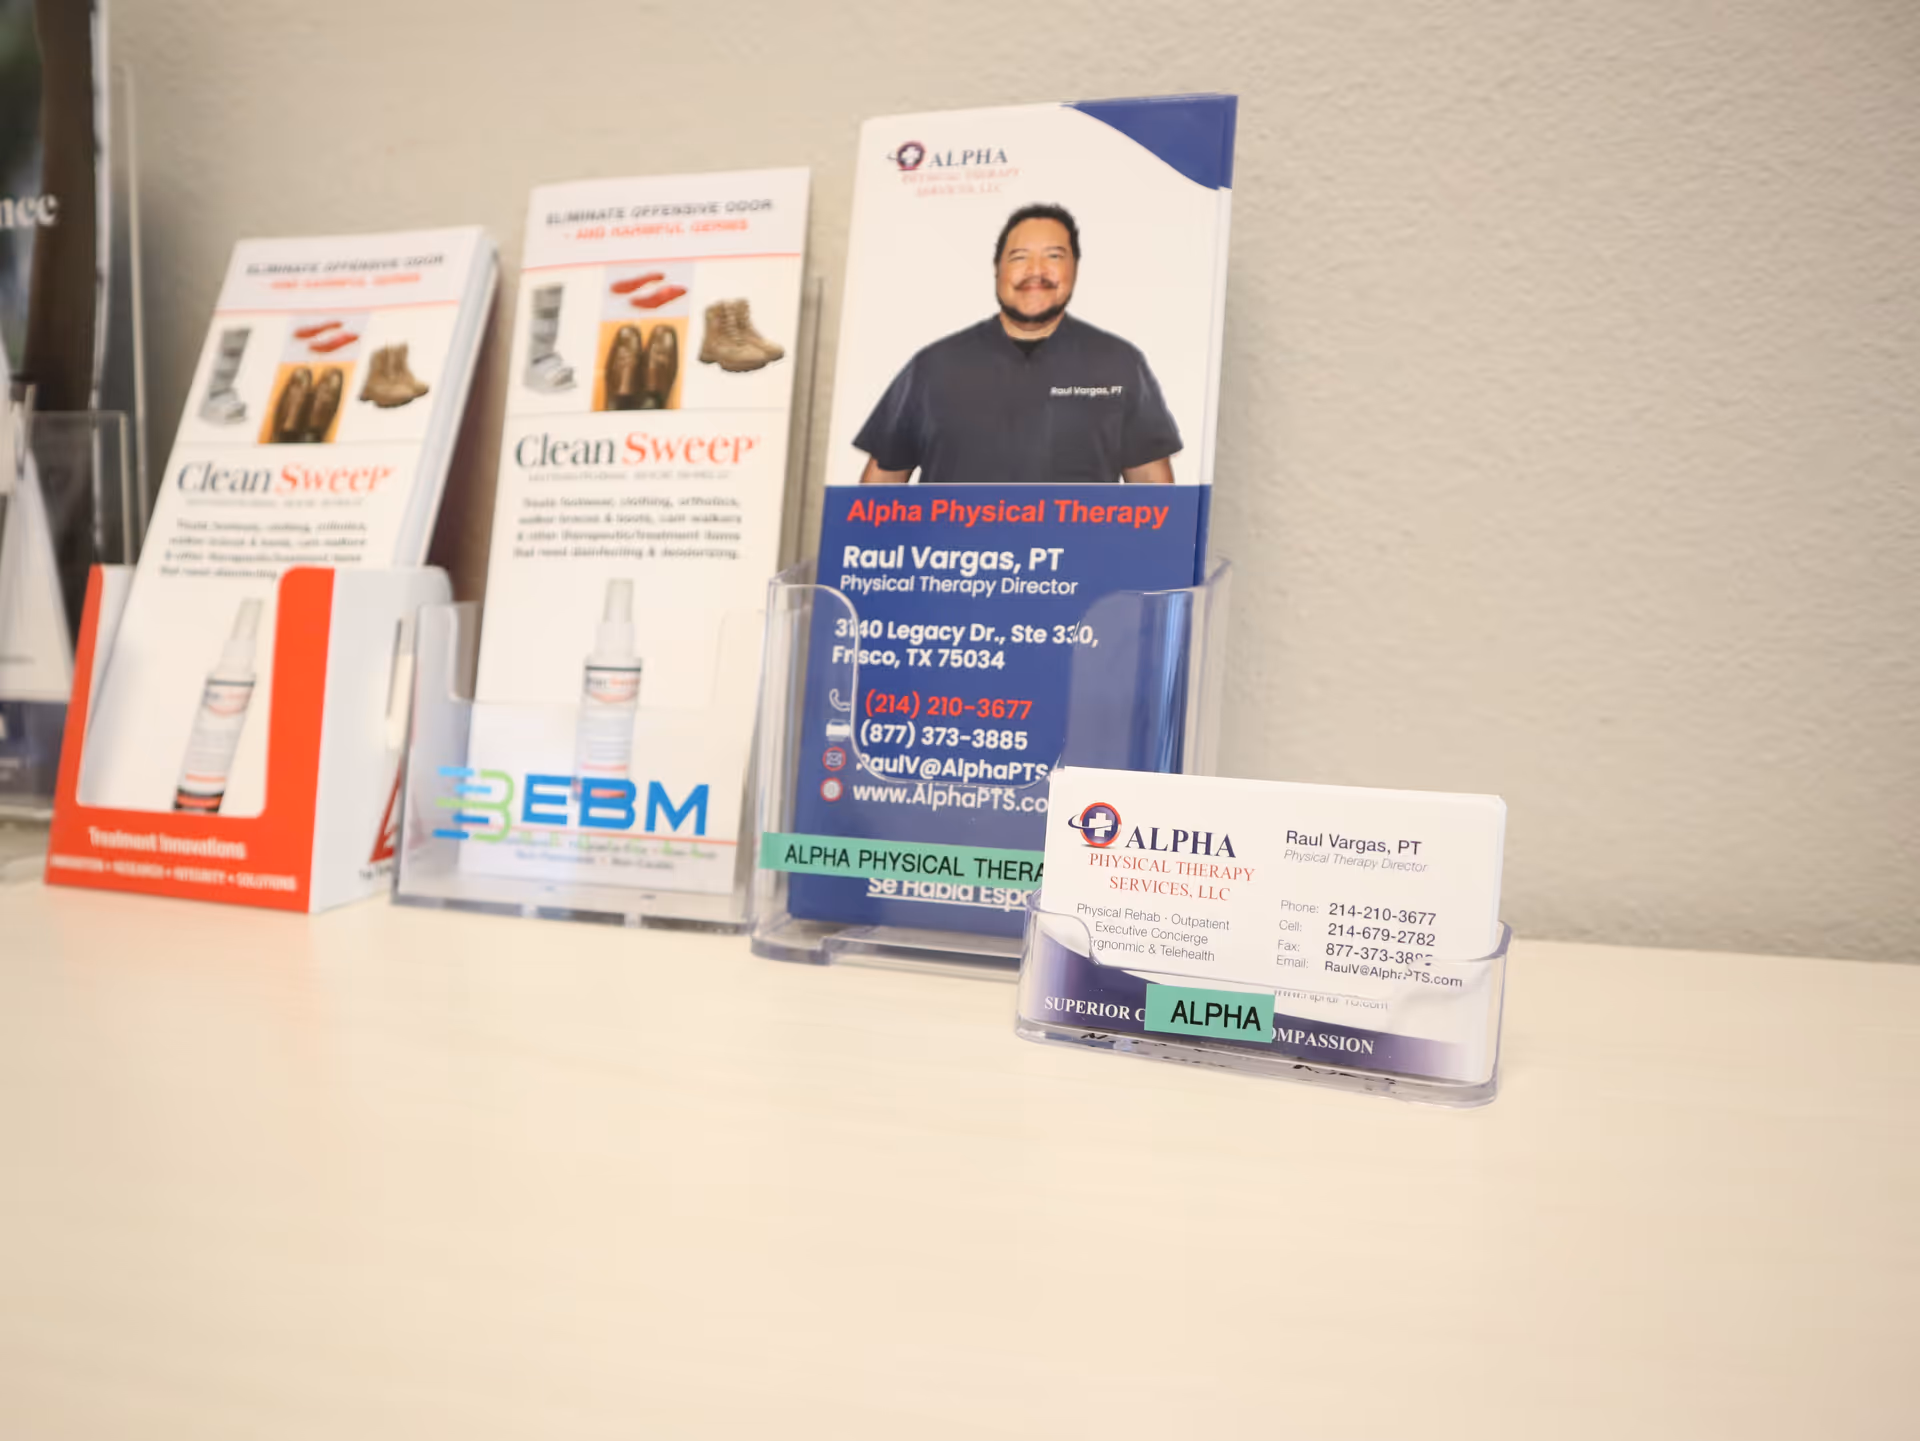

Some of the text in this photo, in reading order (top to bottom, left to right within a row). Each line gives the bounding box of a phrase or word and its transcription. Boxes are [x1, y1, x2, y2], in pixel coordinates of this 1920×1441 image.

[929, 148, 1008, 167] ALPHA
[1050, 386, 1072, 396] Raul
[514, 432, 616, 468] Clean
[176, 462, 272, 494] Clean
[847, 499, 1169, 529] Alpha Physical Therapy
[843, 545, 1064, 577] Raul Vargas, PT
[840, 574, 1079, 598] Physical Therapy Director
[887, 620, 966, 646] Legacy
[970, 624, 1006, 645] Dr.,
[1011, 624, 1047, 644] Ste
[832, 645, 1006, 670] Frsco, TX 75034
[865, 688, 1033, 719] (214) 210-3677
[860, 719, 1028, 750] (877) 373-3885
[521, 774, 709, 836] EBM
[89, 826, 247, 860] Treatment Innovations
[1125, 826, 1236, 858] ALPHA
[1286, 830, 1422, 855] Raul Vargas, PT
[785, 844, 1044, 882] ALPHA PHYSICAL THERA
[1089, 852, 1256, 881] PHYSICAL THERAPY
[1283, 849, 1429, 873] Physical Therapy Director
[867, 877, 896, 894] Se
[1109, 876, 1231, 901] SERVICES, LLC
[1077, 903, 1230, 931] Physical Rehab Outpatient
[1280, 900, 1437, 926] Phone: 214-210-3677
[1095, 921, 1209, 946] Executive Concierge
[1277, 939, 1300, 952] Fax:
[1279, 919, 1436, 947] Cell: 214-679-2782
[1148, 944, 1157, 954] &
[1160, 944, 1215, 961] Telehealth
[1276, 955, 1309, 969] Email:
[1044, 996, 1130, 1020] SUPERIOR
[1170, 1000, 1261, 1032] ALPHA
